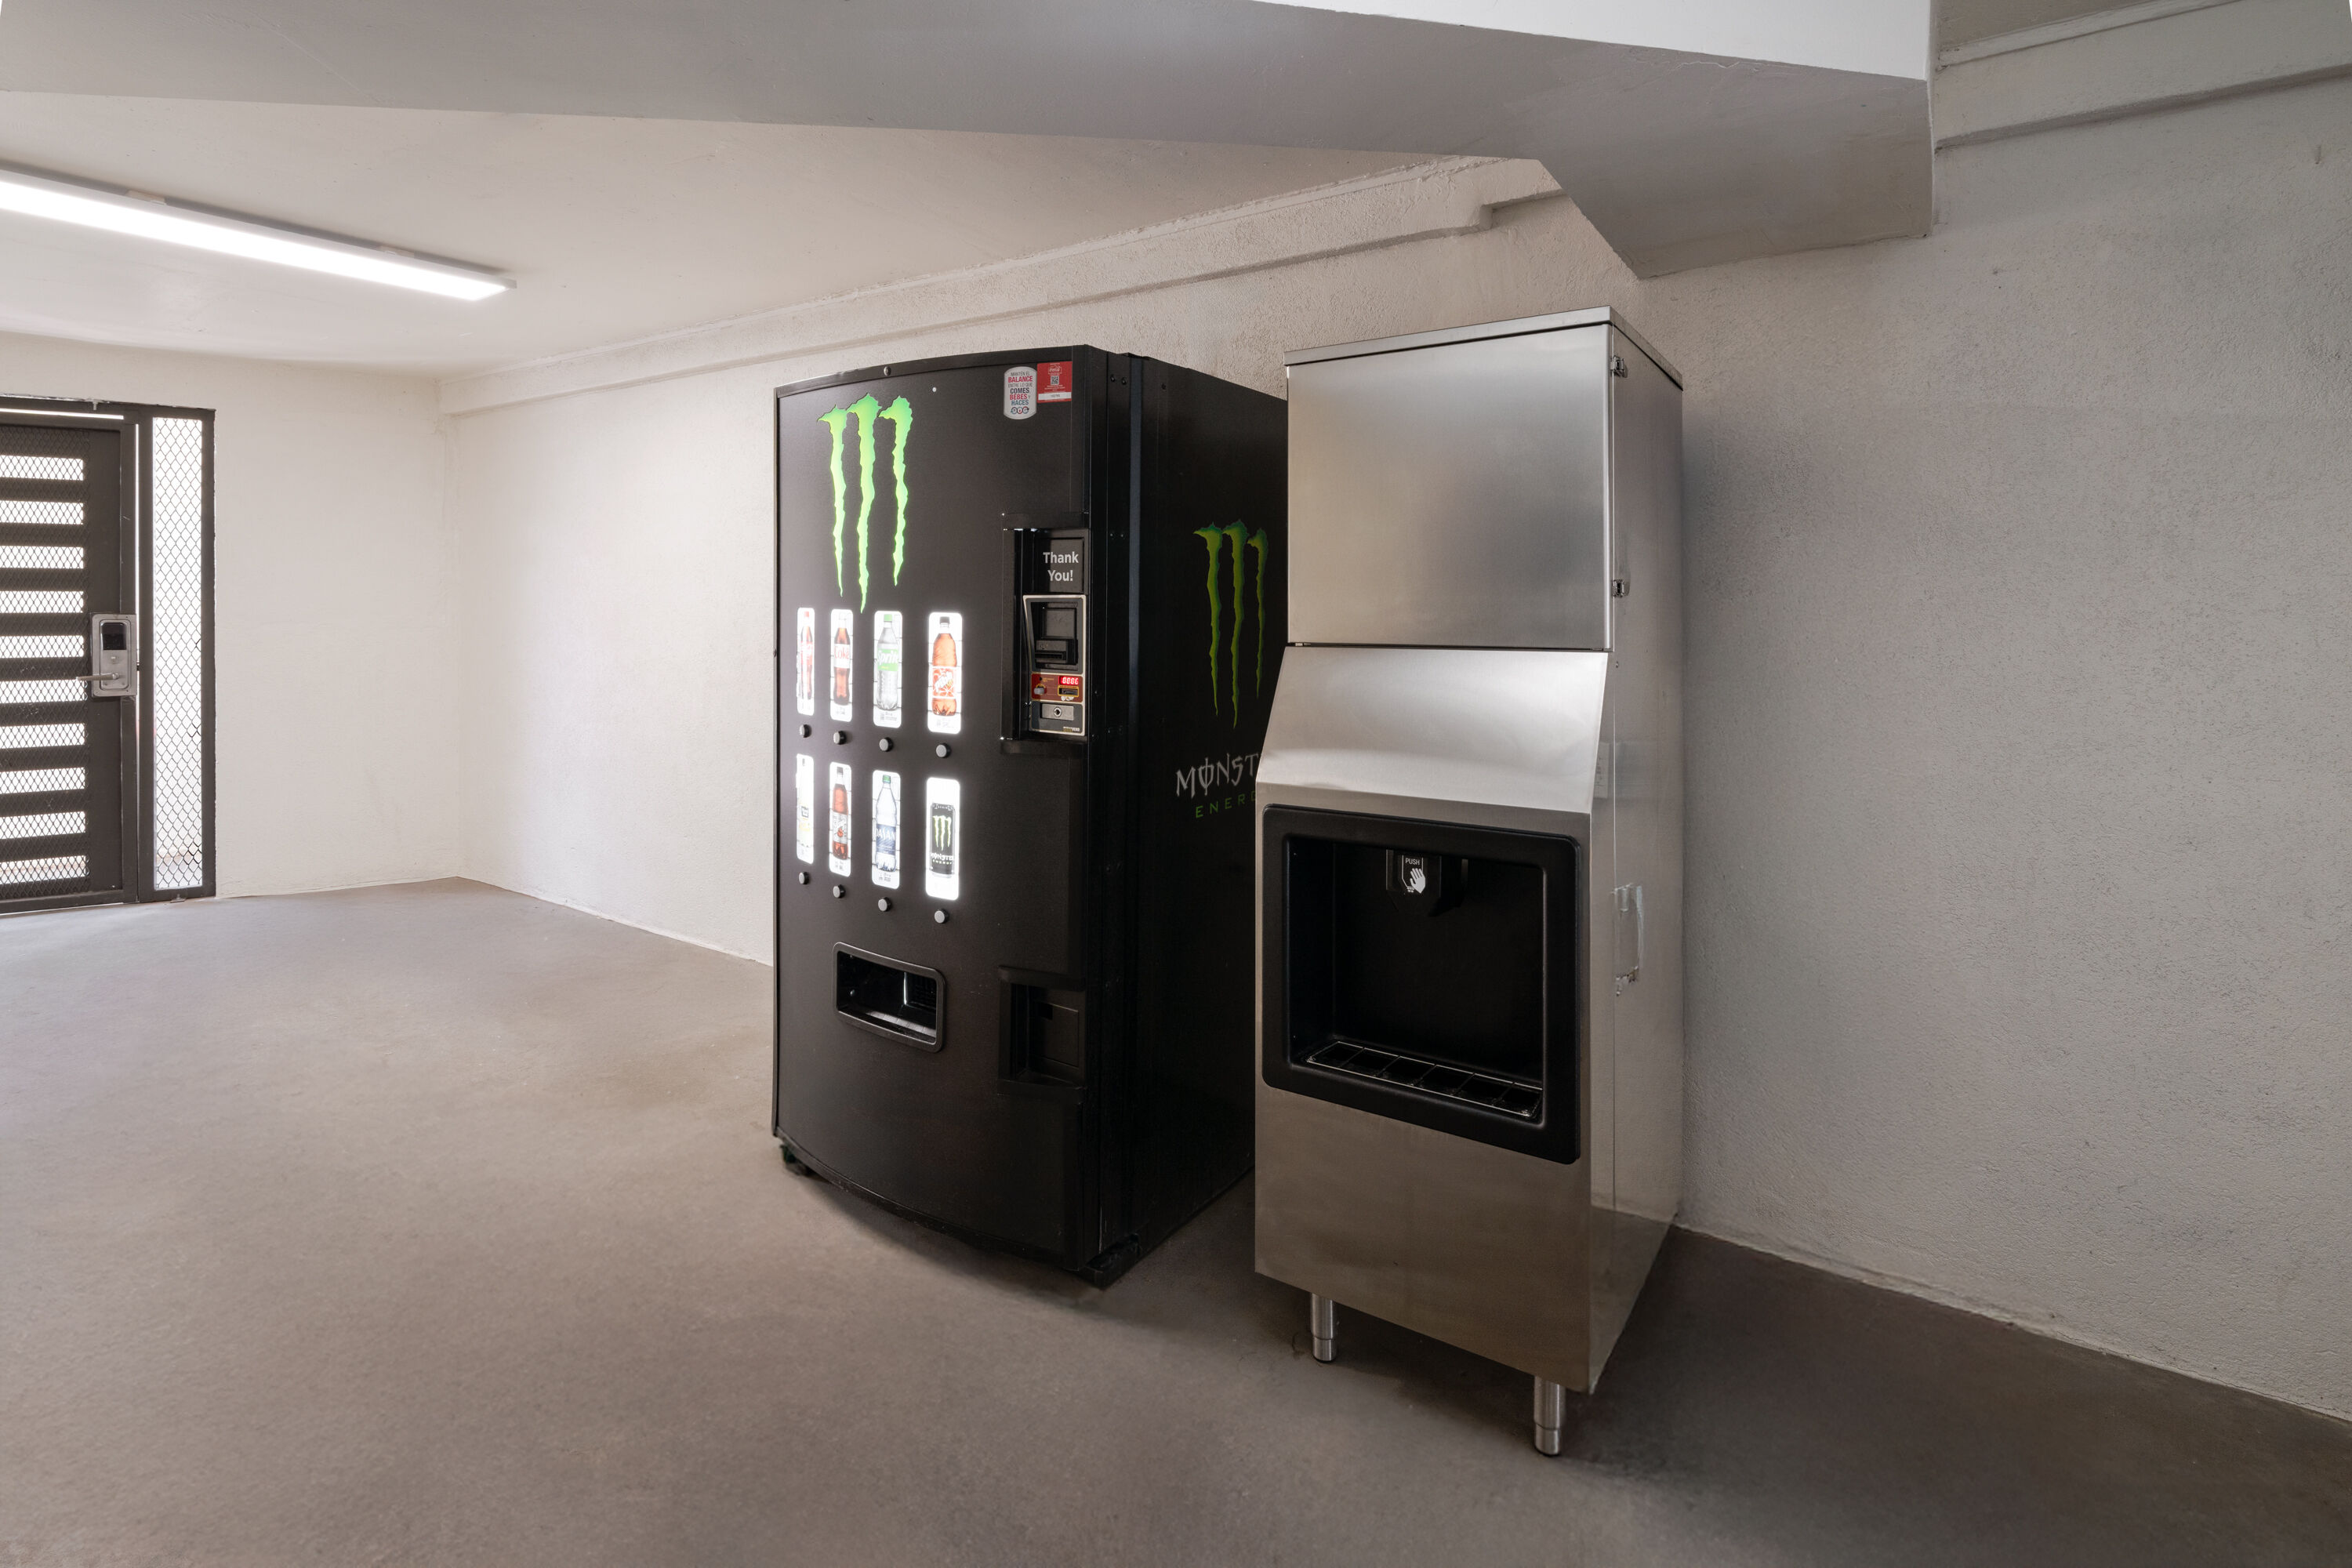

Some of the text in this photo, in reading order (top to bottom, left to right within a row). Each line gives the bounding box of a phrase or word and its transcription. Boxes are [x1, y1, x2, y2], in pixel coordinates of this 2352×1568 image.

[1043, 551, 1079, 564] Thank
[1047, 569, 1073, 582] You!
[1176, 753, 1261, 799] MONST
[1196, 790, 1256, 818] ENERG
[876, 827, 895, 841] DASAN
